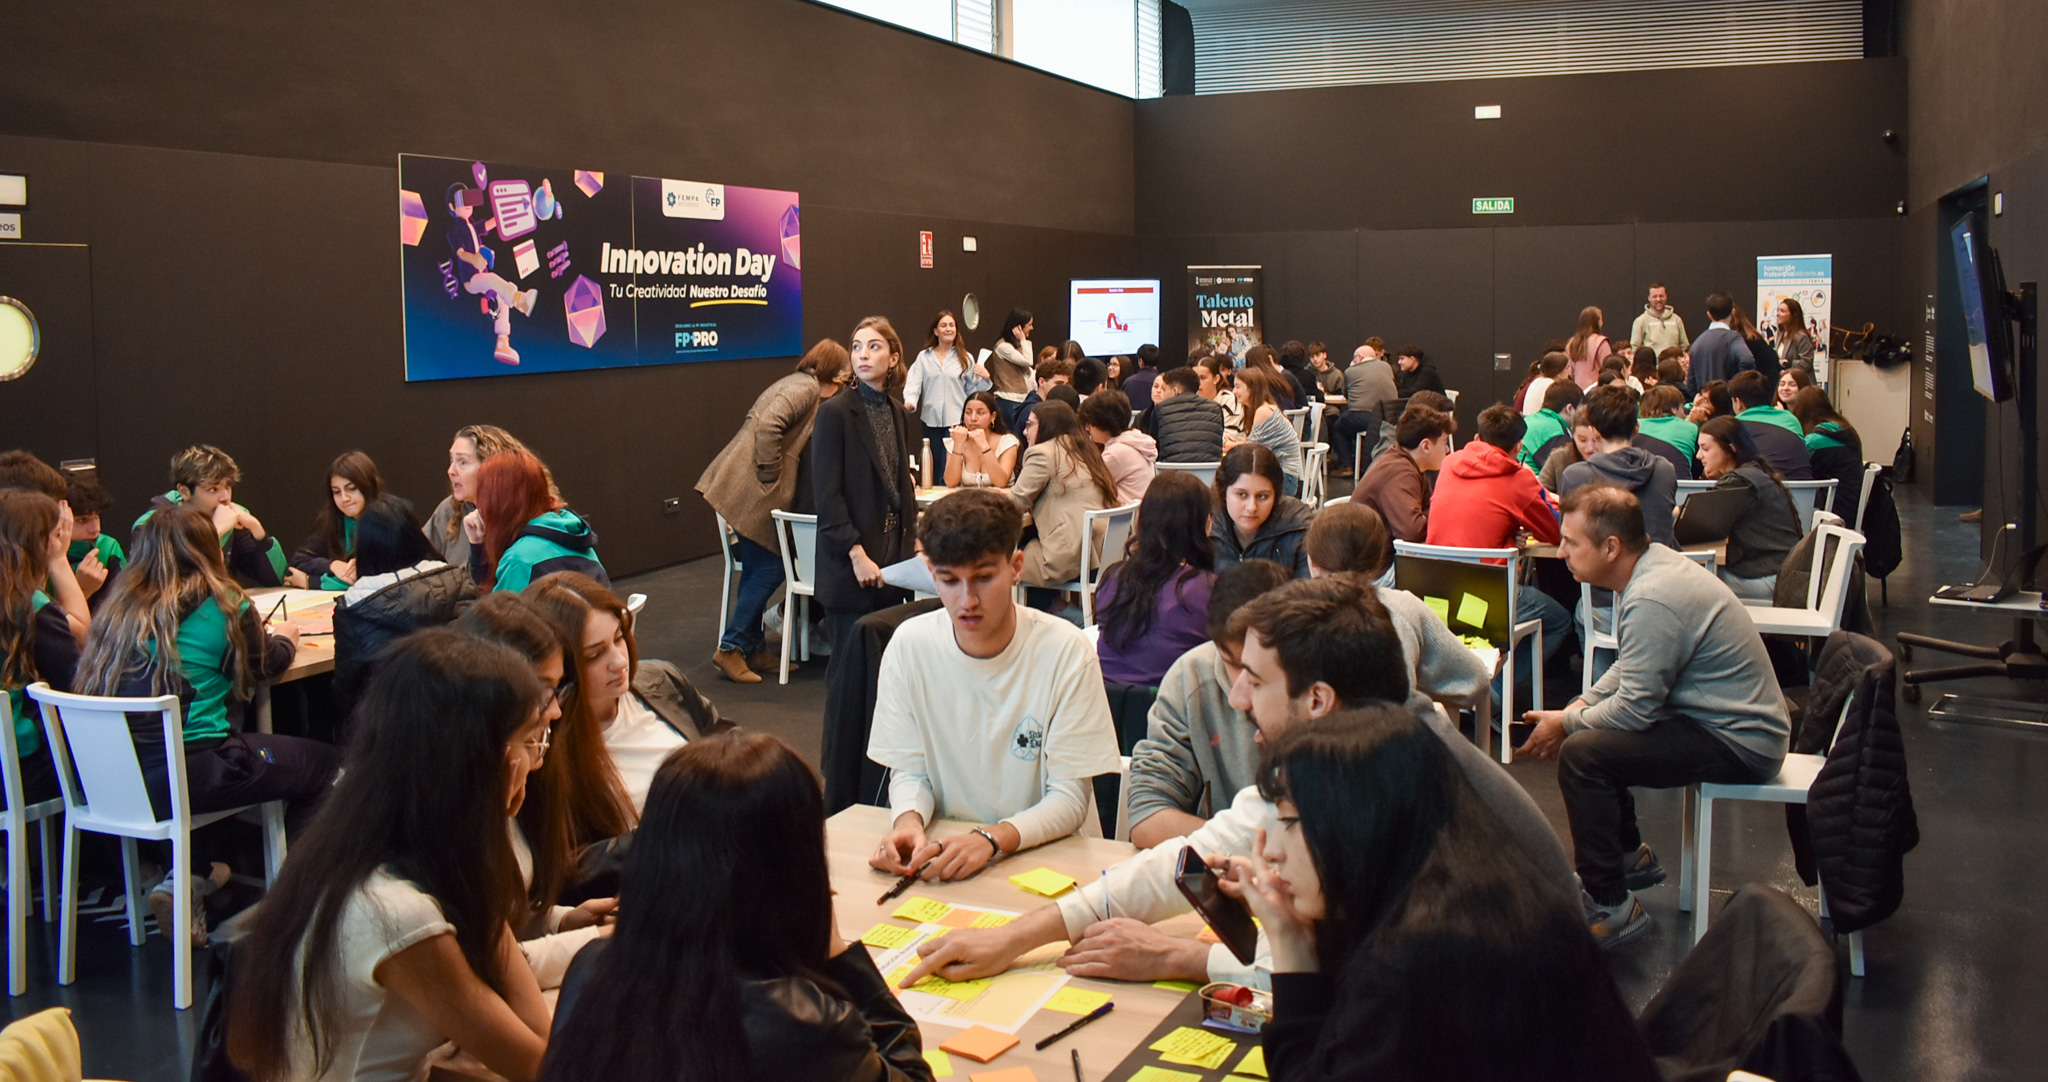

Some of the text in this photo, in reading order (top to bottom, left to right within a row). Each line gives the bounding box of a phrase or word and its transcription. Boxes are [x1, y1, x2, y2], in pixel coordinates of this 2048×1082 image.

[711, 198, 720, 207] FP
[1476, 201, 1511, 210] SALIDA
[601, 242, 776, 283] Innovation Day
[609, 283, 767, 298] Tu Creatividad Nuestro Desafío
[1195, 293, 1254, 308] Talento
[1201, 308, 1254, 327] Metal
